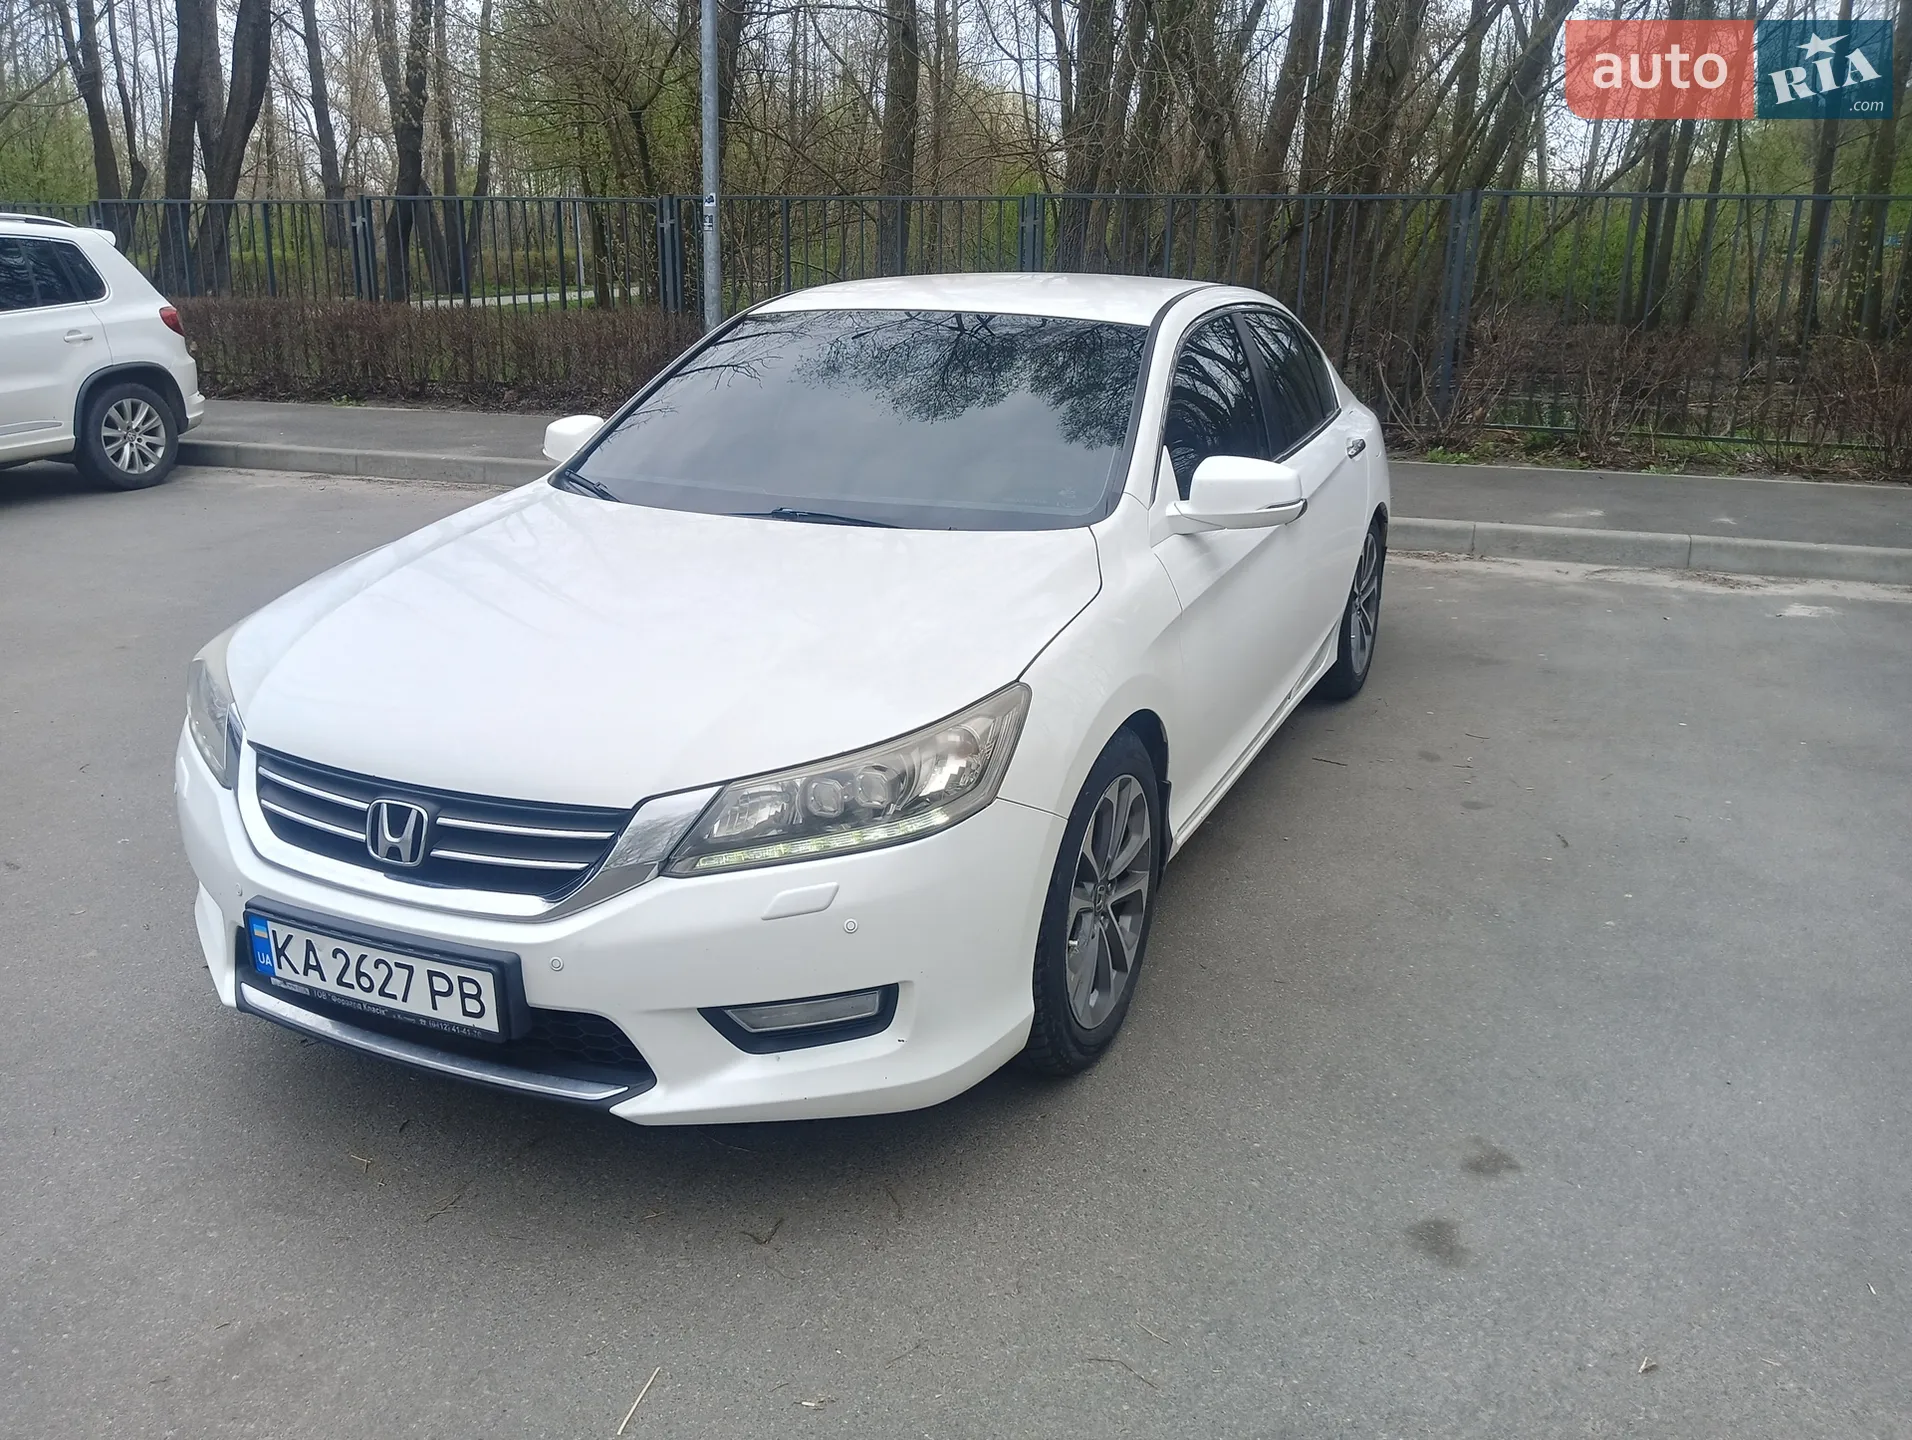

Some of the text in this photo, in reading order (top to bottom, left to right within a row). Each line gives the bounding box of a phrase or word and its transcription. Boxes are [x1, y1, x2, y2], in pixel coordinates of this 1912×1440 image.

[257, 953, 273, 968] UA
[272, 930, 486, 1019] KA 2627 PB
